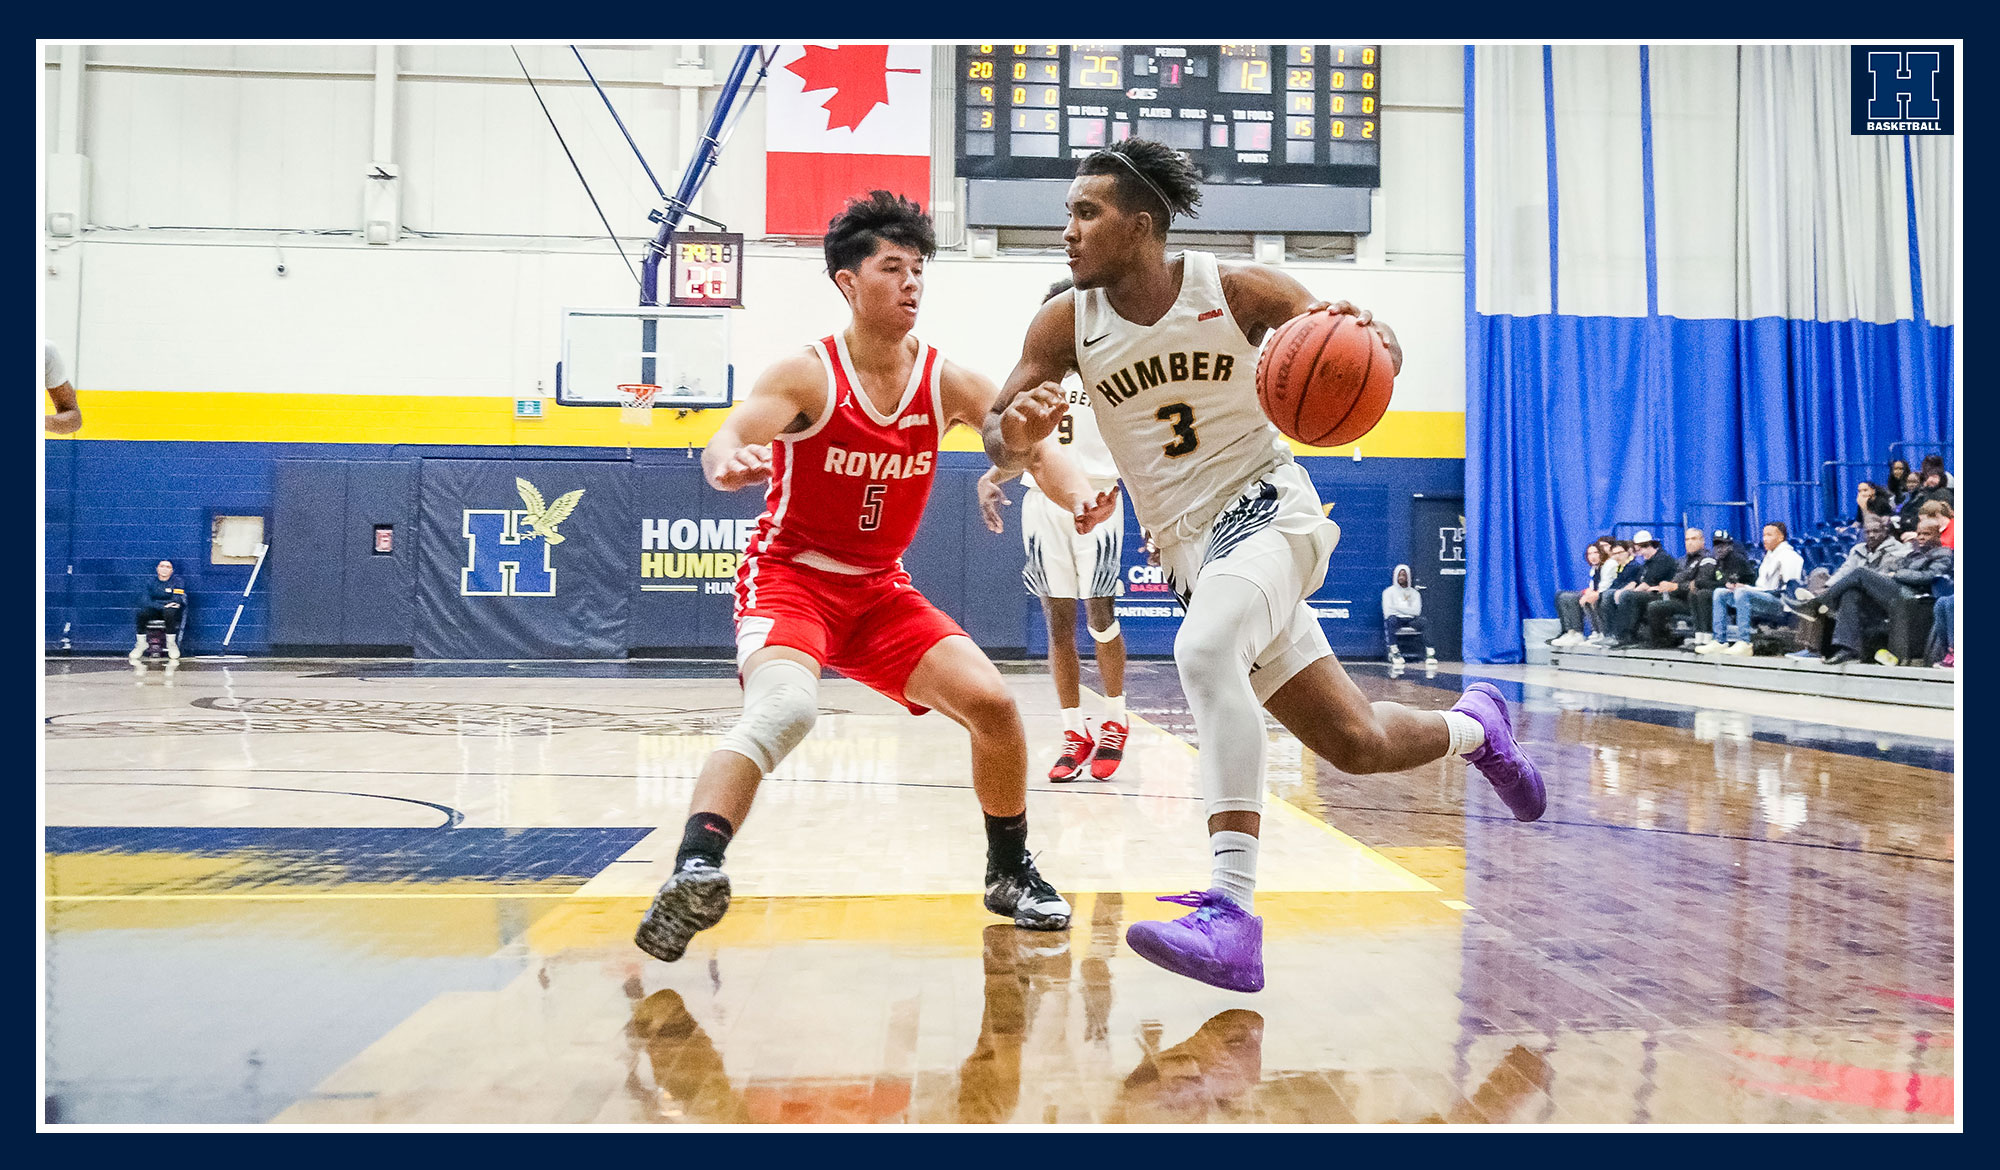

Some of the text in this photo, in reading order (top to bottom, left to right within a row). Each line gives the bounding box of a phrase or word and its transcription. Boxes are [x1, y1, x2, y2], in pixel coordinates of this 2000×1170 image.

[1300, 47, 1375, 65] 5 1 0
[969, 61, 1058, 80] 20 0 4
[1079, 55, 1119, 87] 25
[1170, 64, 1179, 84] 1
[1240, 60, 1268, 91] 12
[1288, 70, 1375, 90] 22 0 0
[980, 86, 1057, 105] 9 0 0
[1294, 96, 1375, 114] 14 0 0
[981, 111, 1057, 130] 3 1 5
[1294, 120, 1375, 138] 15 0 2
[1096, 352, 1234, 408] HUMBER
[1057, 414, 1074, 446] 9
[1154, 401, 1200, 459] 3
[824, 446, 933, 480] ROYALS
[858, 484, 888, 531] 5
[461, 509, 557, 597] H
[640, 552, 747, 579] HUMB
